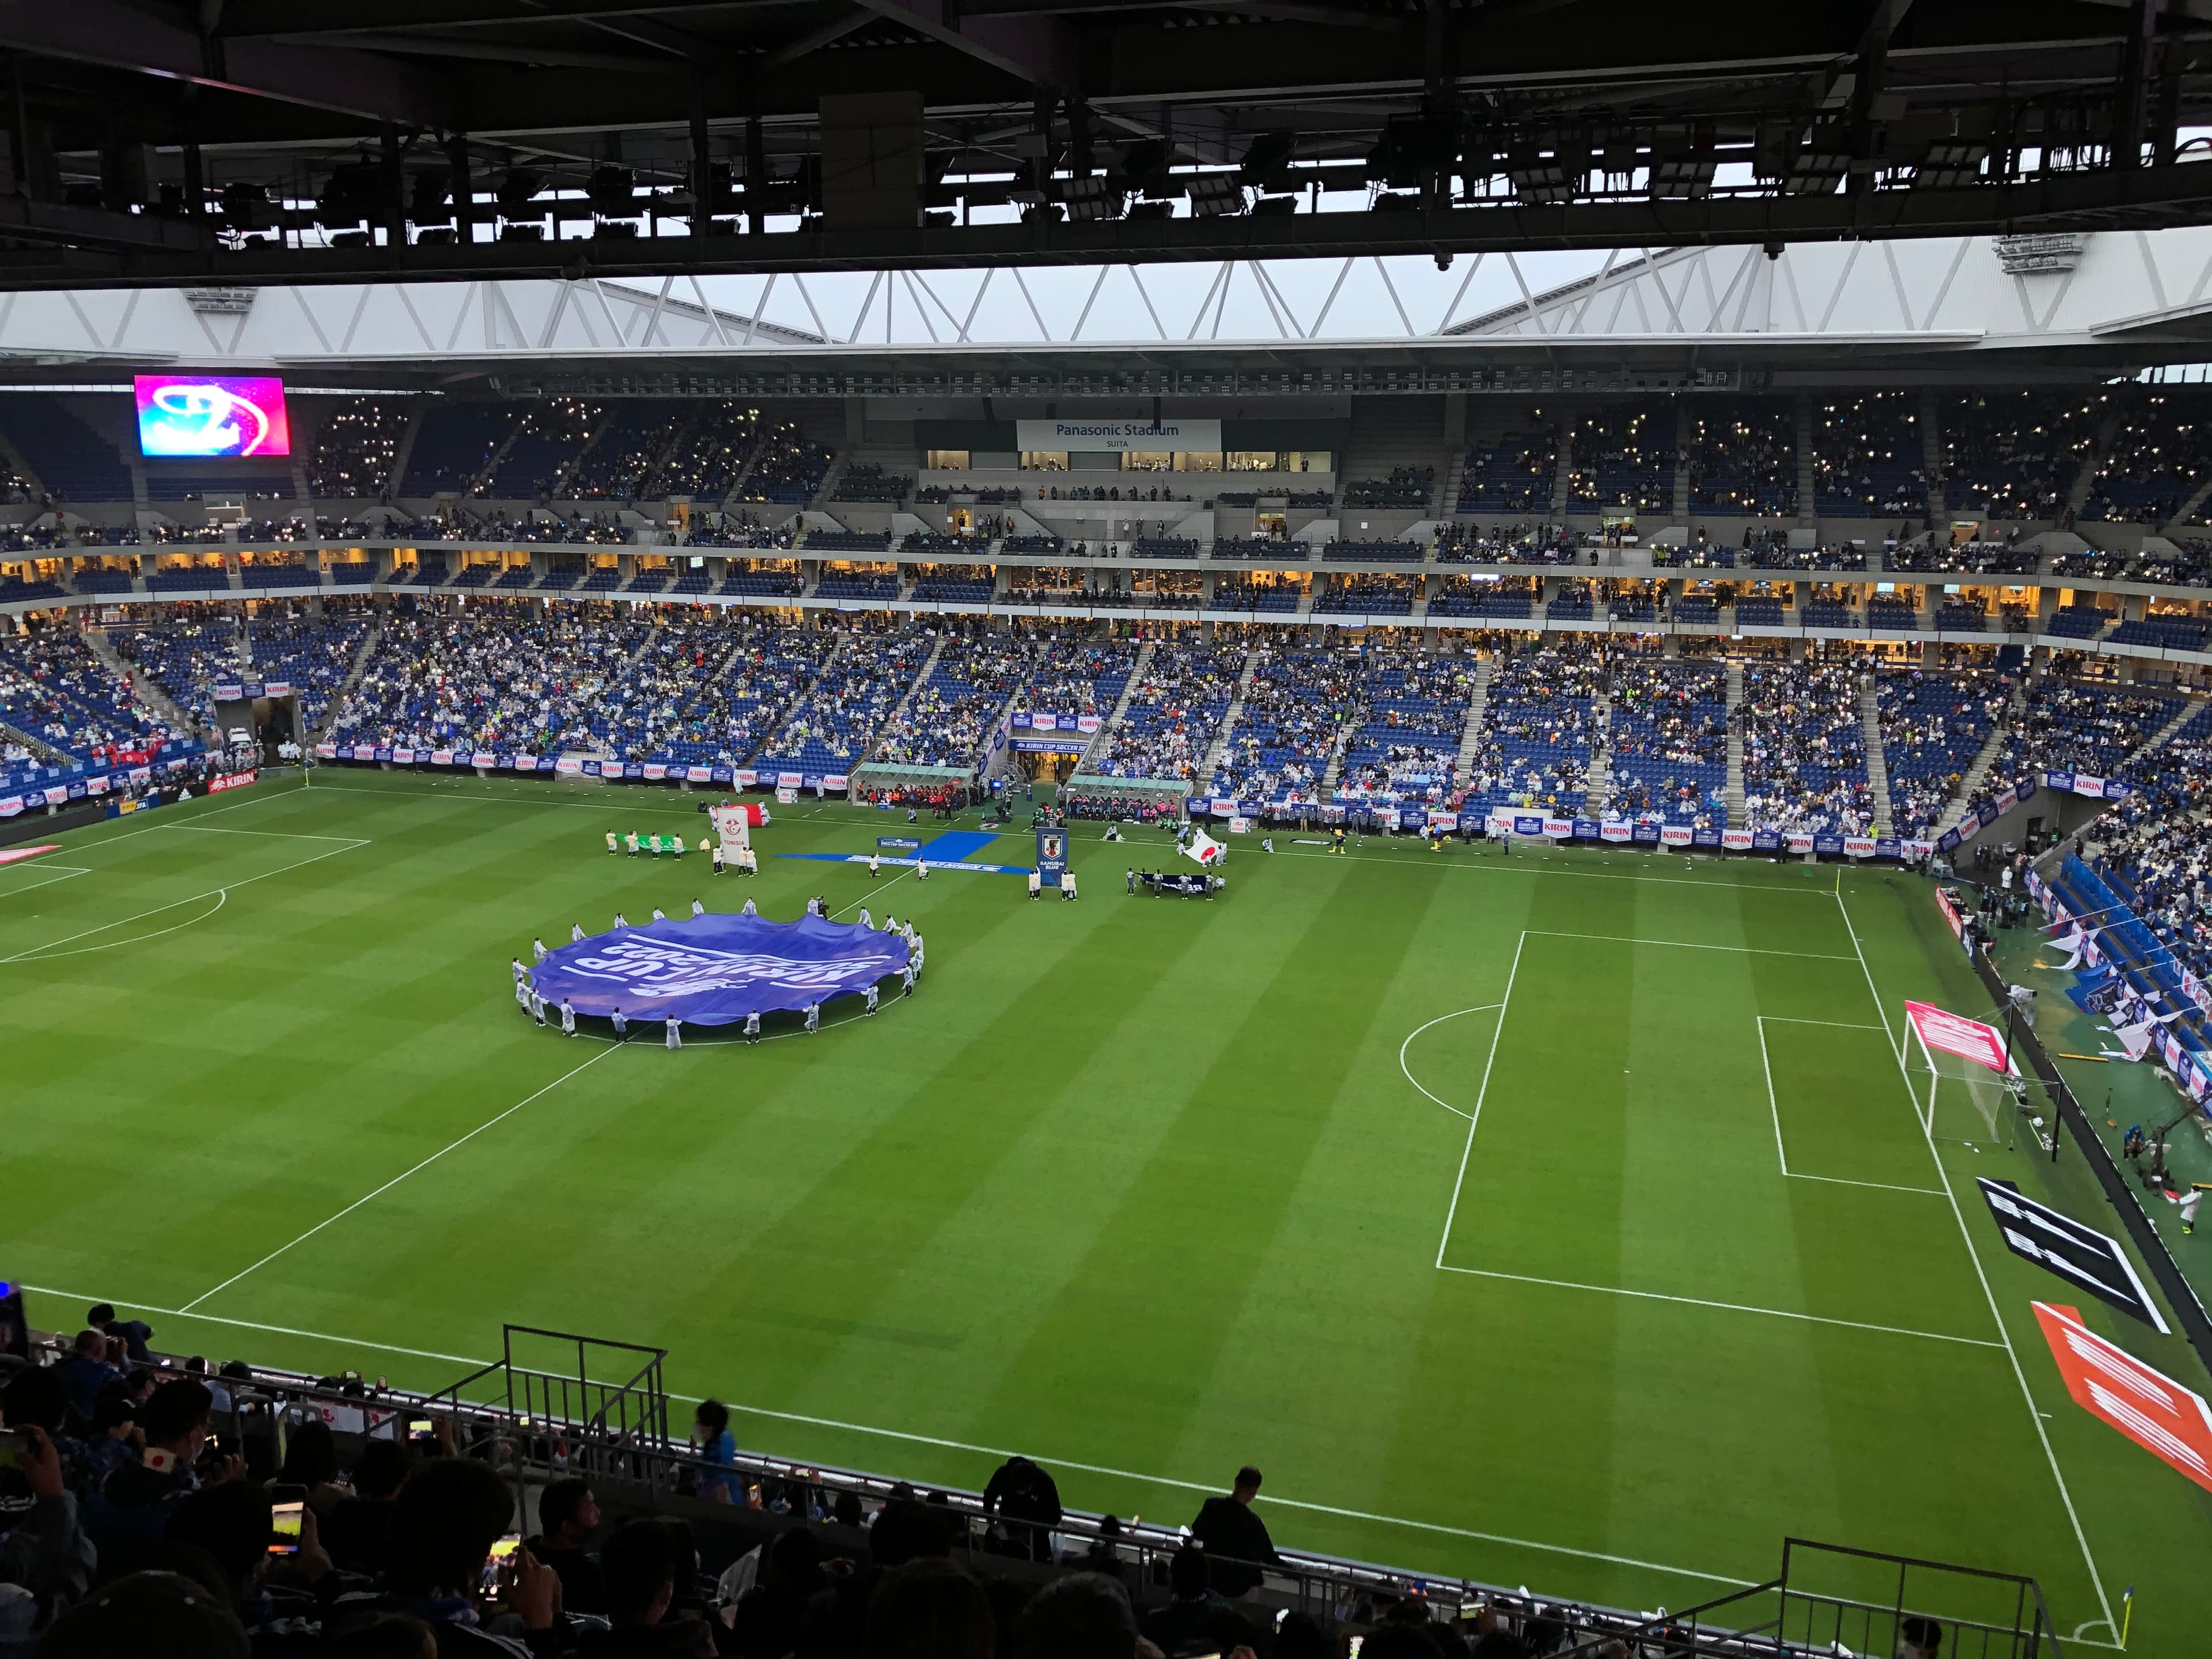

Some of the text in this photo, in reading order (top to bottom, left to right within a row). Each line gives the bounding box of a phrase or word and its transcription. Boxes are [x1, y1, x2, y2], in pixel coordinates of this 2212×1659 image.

[1056, 424, 1179, 435] Panasonic Stadium
[226, 772, 254, 788] KIRIN
[779, 775, 801, 783] KIRIN
[824, 778, 846, 786] KIRIN
[2076, 779, 2102, 791] KIRIN
[1213, 802, 1234, 811] KIRIN
[1430, 817, 1455, 825] KIRIN
[1544, 823, 1570, 832] KIRIN
[1603, 827, 1630, 835] KIRIN
[1960, 819, 1978, 835] KIRIN
[1662, 831, 1690, 839] KIRIN
[1724, 835, 1751, 843] KIRIN
[1846, 842, 1874, 851] KIRIN
[1903, 846, 1931, 854] KRIN
[601, 941, 709, 965] 2022
[574, 958, 696, 981] CUP
